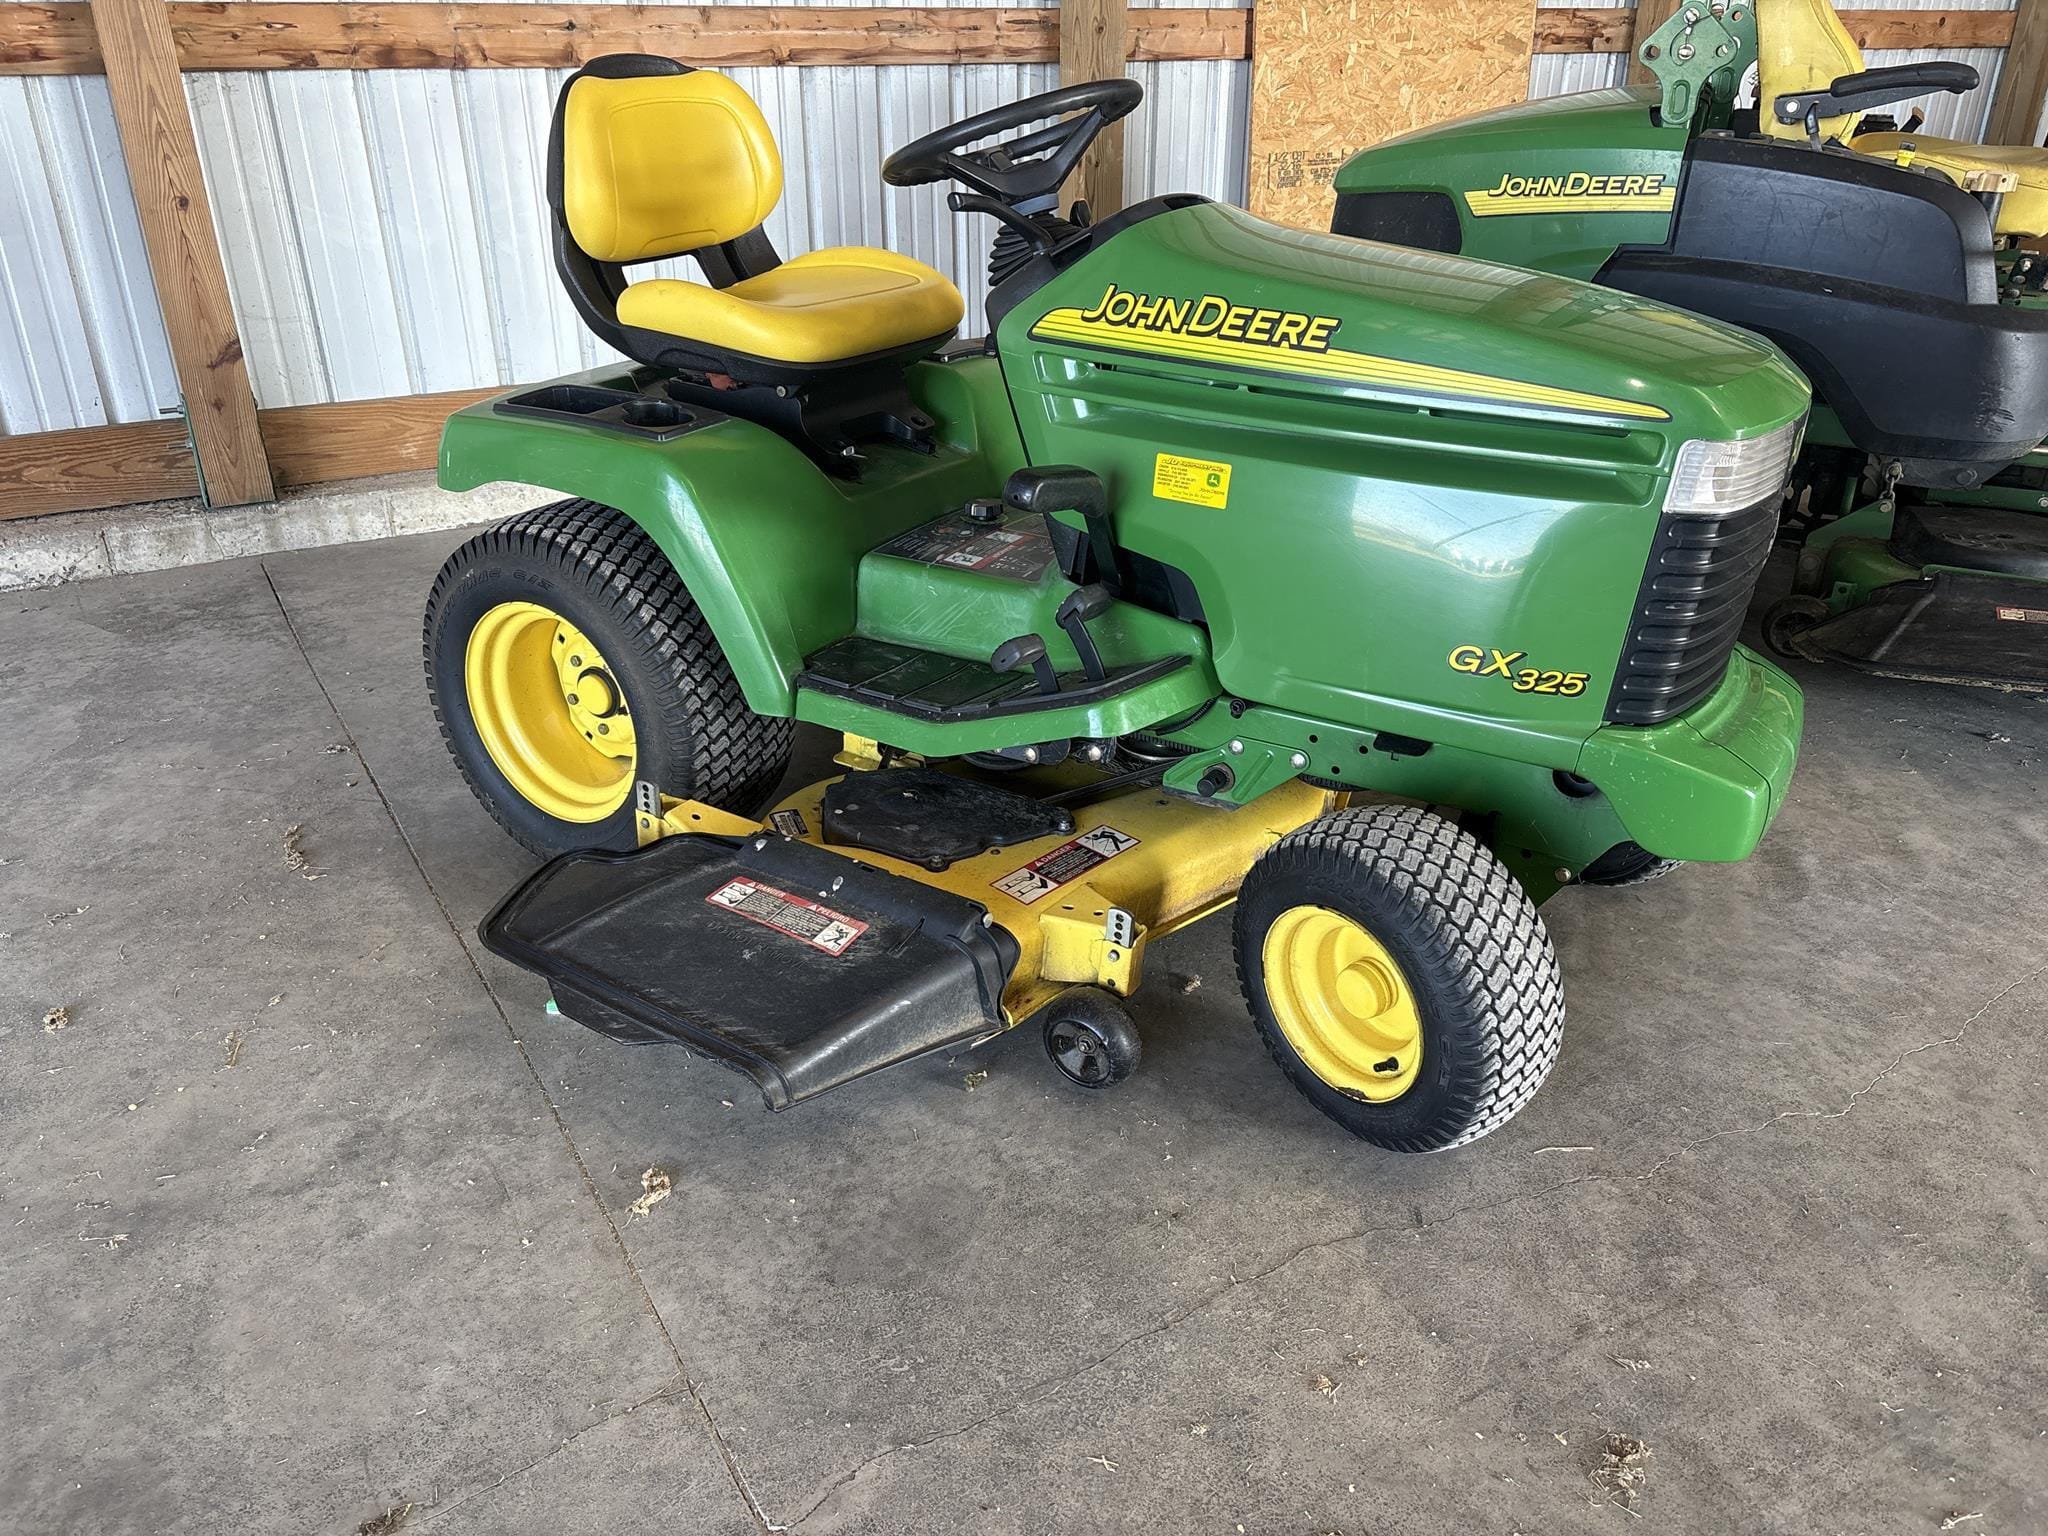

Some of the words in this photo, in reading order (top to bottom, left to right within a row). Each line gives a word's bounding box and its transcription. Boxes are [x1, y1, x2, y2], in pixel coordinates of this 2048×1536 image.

[1488, 173, 1564, 197] JOHN
[1562, 172, 1666, 196] DEERE
[1081, 283, 1194, 334] JOHN
[1187, 294, 1342, 354] DEERE
[1042, 845, 1073, 863] DANGER
[755, 883, 787, 898] DANGER
[816, 904, 850, 923] PELIGRO
